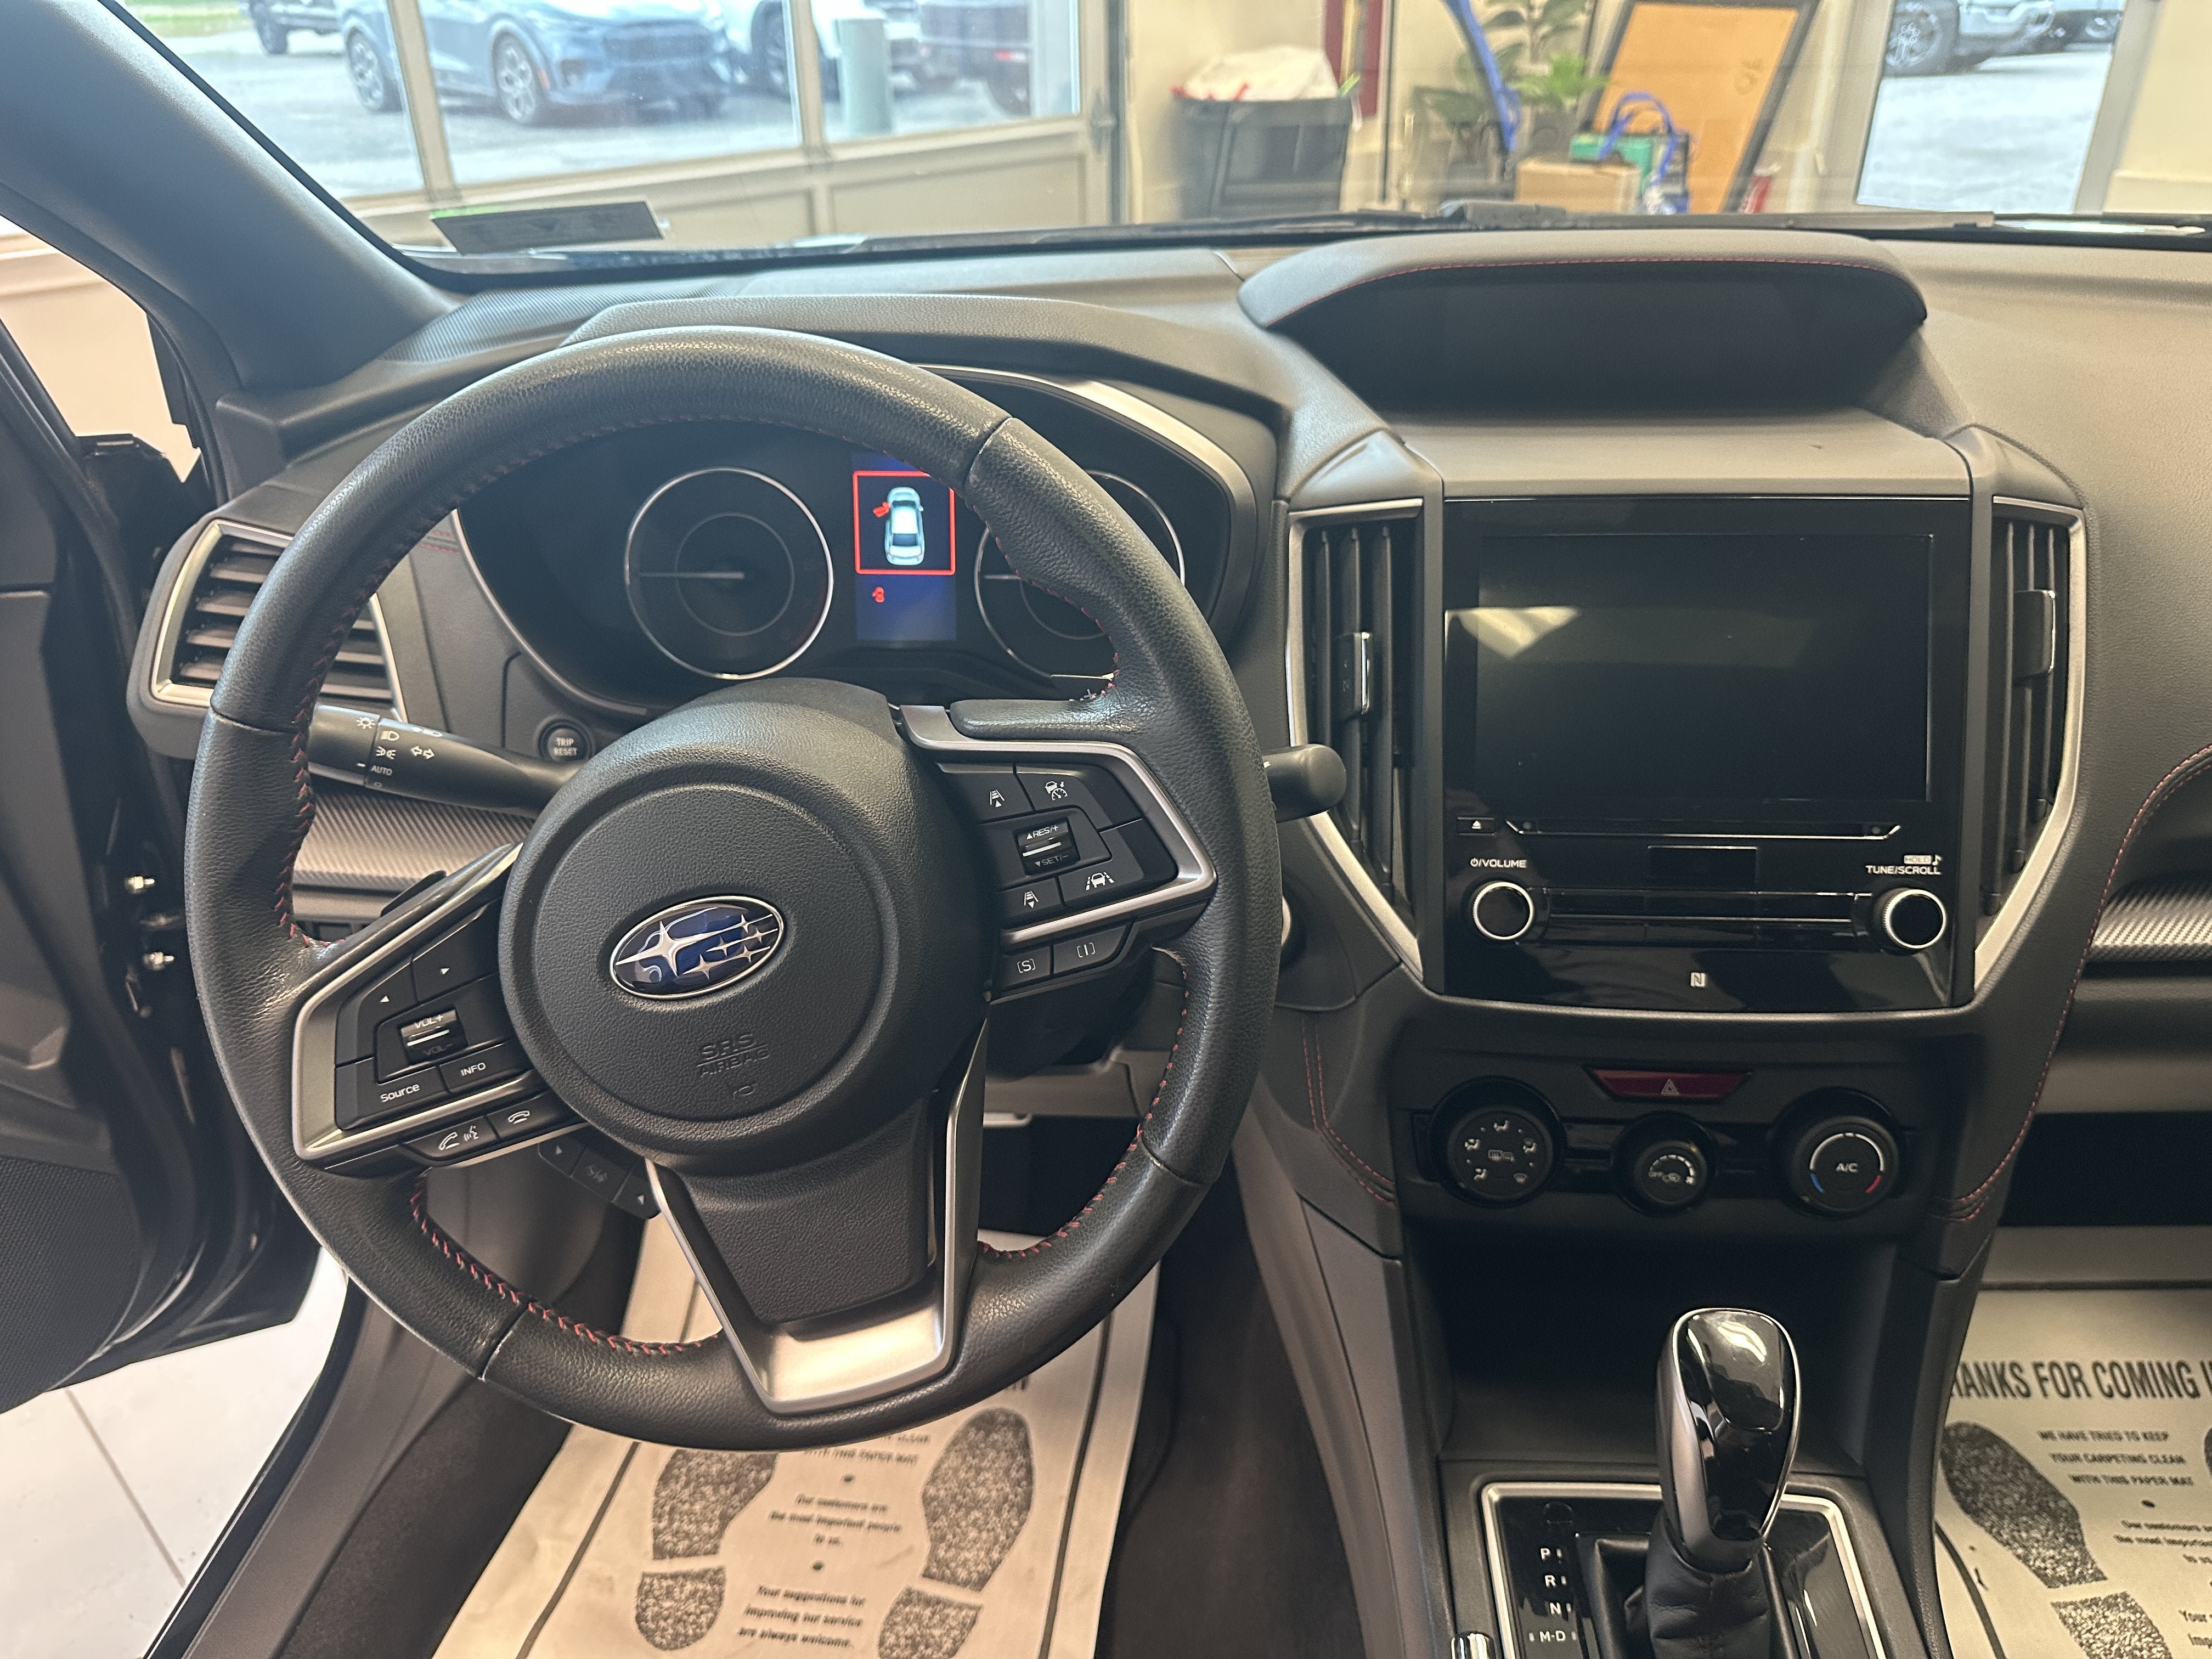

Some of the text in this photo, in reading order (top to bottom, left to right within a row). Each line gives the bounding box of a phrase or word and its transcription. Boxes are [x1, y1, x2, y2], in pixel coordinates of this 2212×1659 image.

[555, 737, 574, 747] TRIP
[553, 747, 578, 756] RESET
[371, 765, 393, 776] AUTO
[1865, 865, 1942, 875] TUNE/SCROLL
[703, 1034, 757, 1060] SRS
[460, 1062, 487, 1076] INFO
[380, 1084, 420, 1103] Source
[1835, 1163, 1858, 1173] A/C
[2032, 1361, 2092, 1398] FOR
[2092, 1360, 2201, 1399] COMING
[2037, 1430, 2057, 1441] WE
[2058, 1430, 2088, 1441] HAVE
[2123, 1431, 2140, 1442] TO
[1540, 1548, 1551, 1560] P
[1544, 1575, 1557, 1588] R
[1550, 1602, 1562, 1615] N
